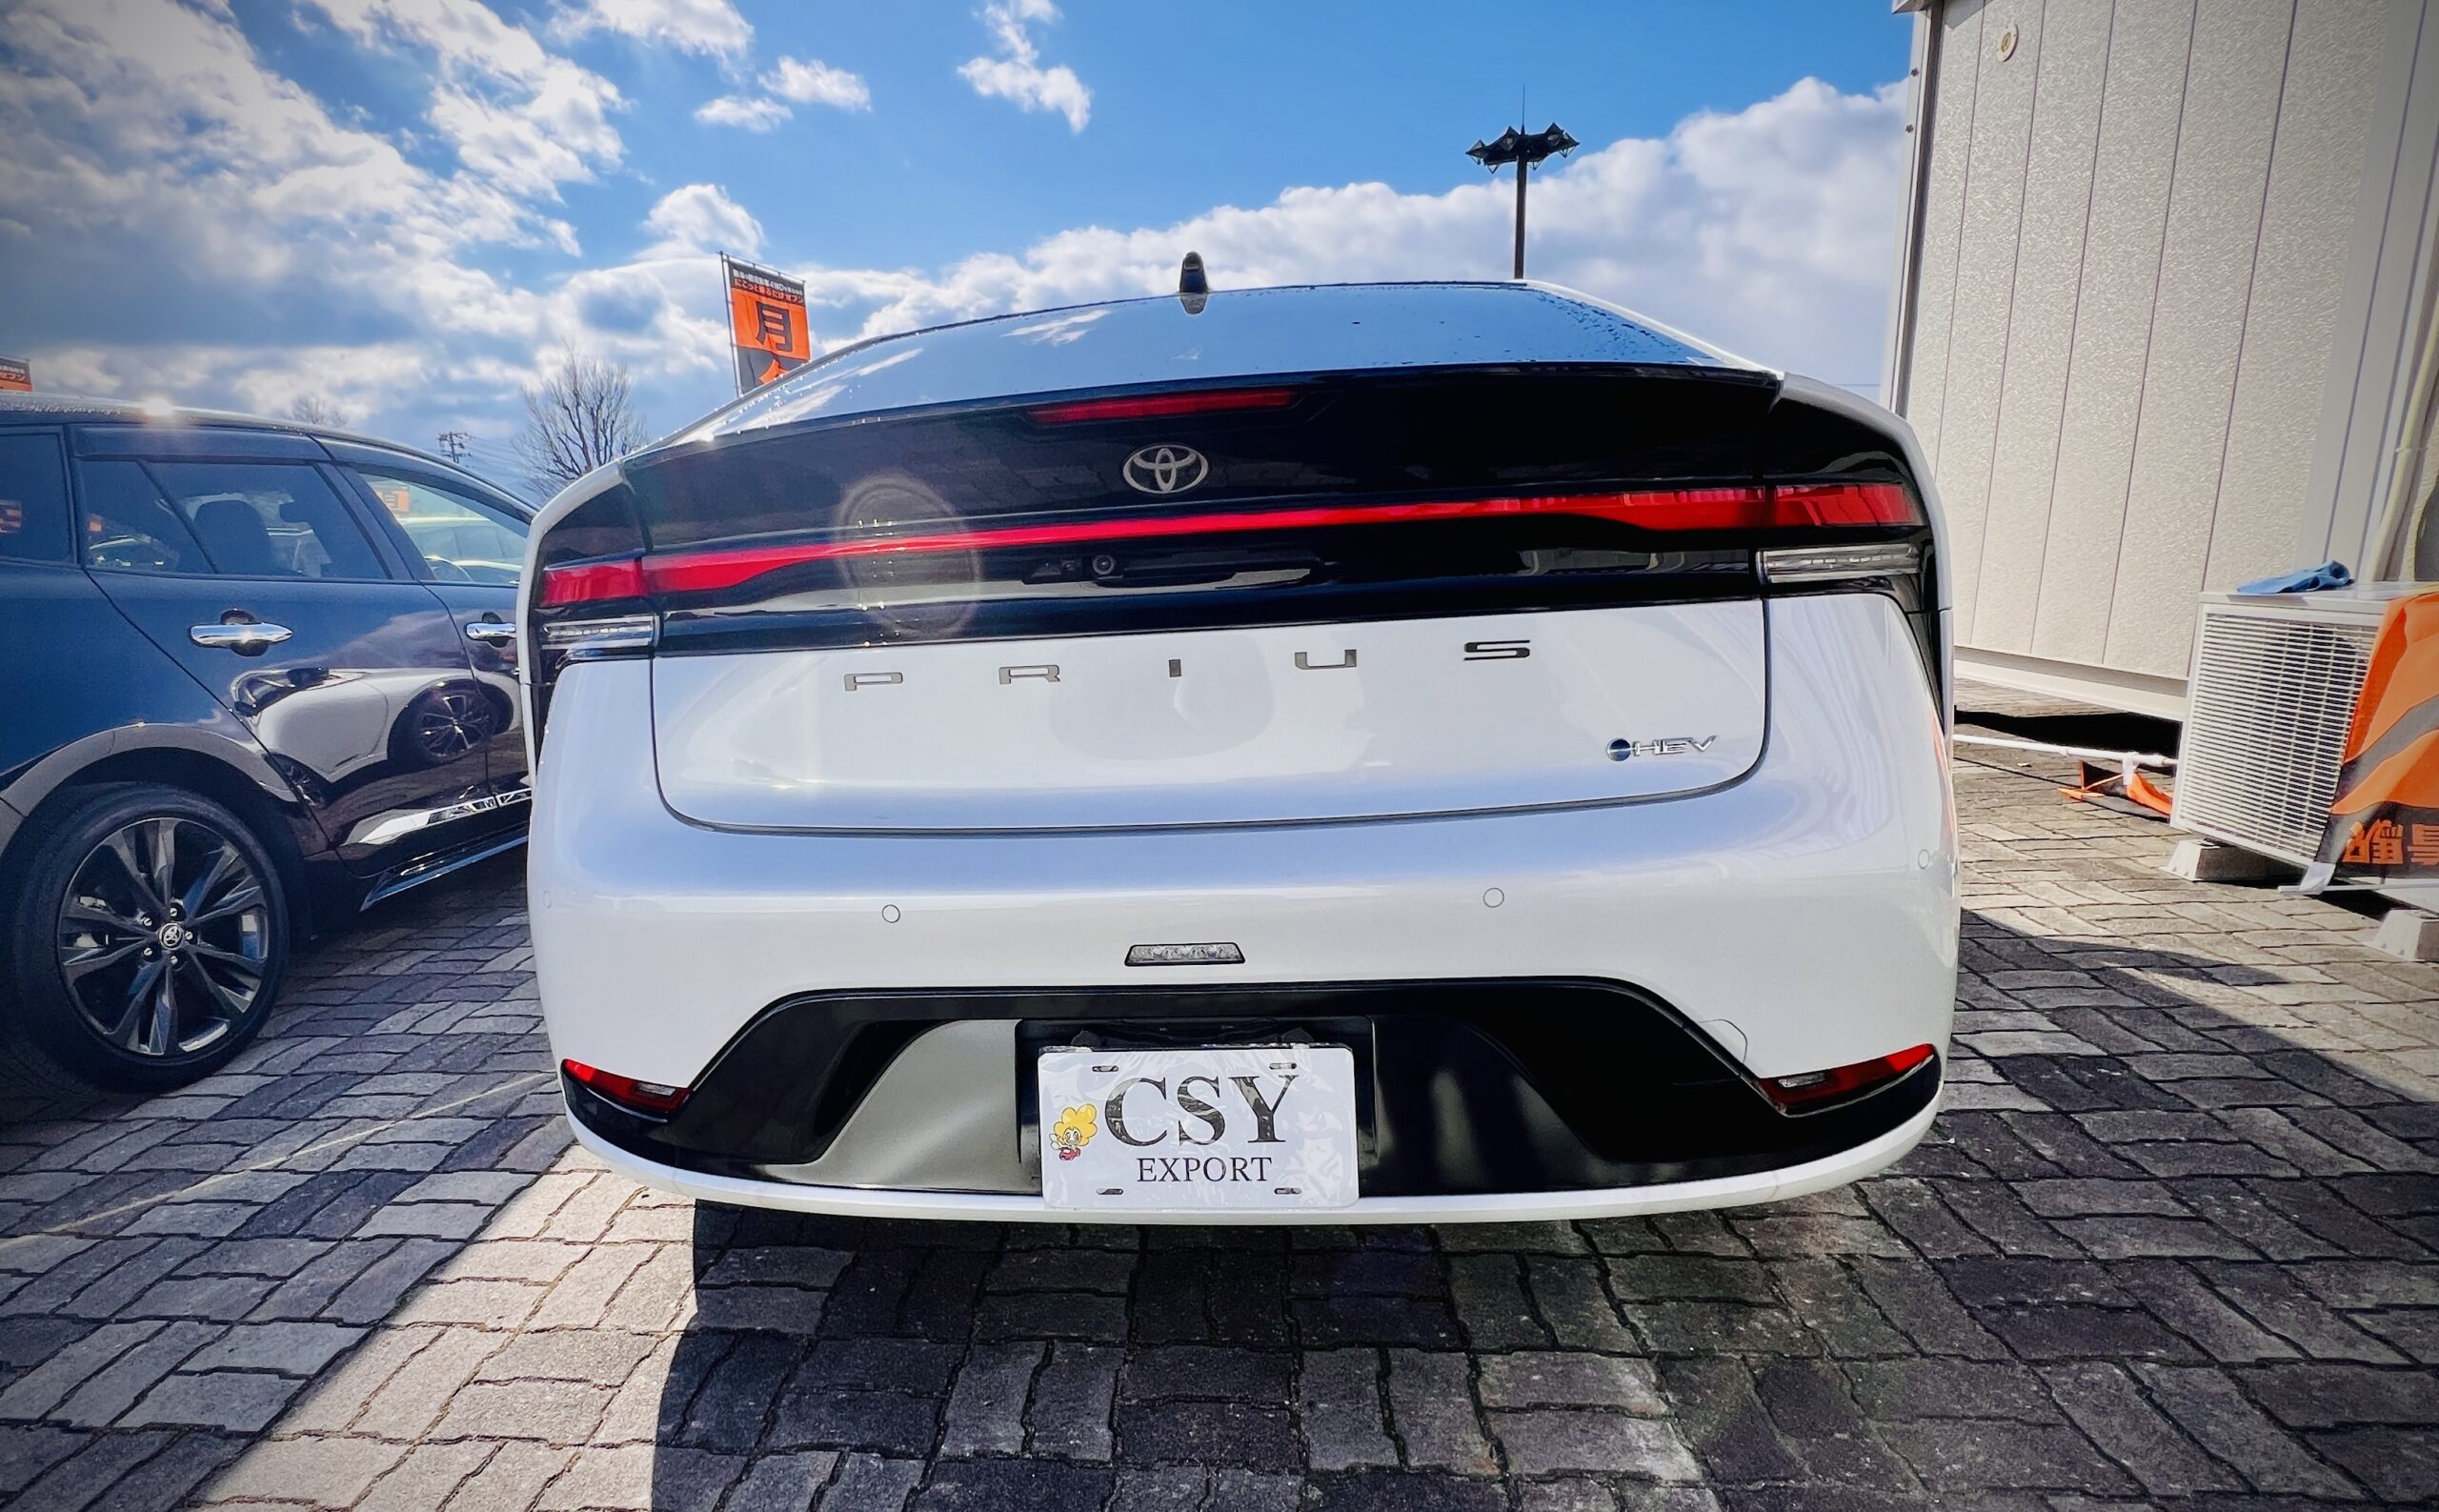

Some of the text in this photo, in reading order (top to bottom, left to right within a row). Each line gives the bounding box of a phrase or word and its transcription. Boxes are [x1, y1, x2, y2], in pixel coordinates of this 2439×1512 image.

[844, 639, 1531, 692] PRIUS
[1631, 735, 1718, 757] HEV
[1104, 1074, 1300, 1147] CSY
[1137, 1156, 1272, 1182] EXPORT
